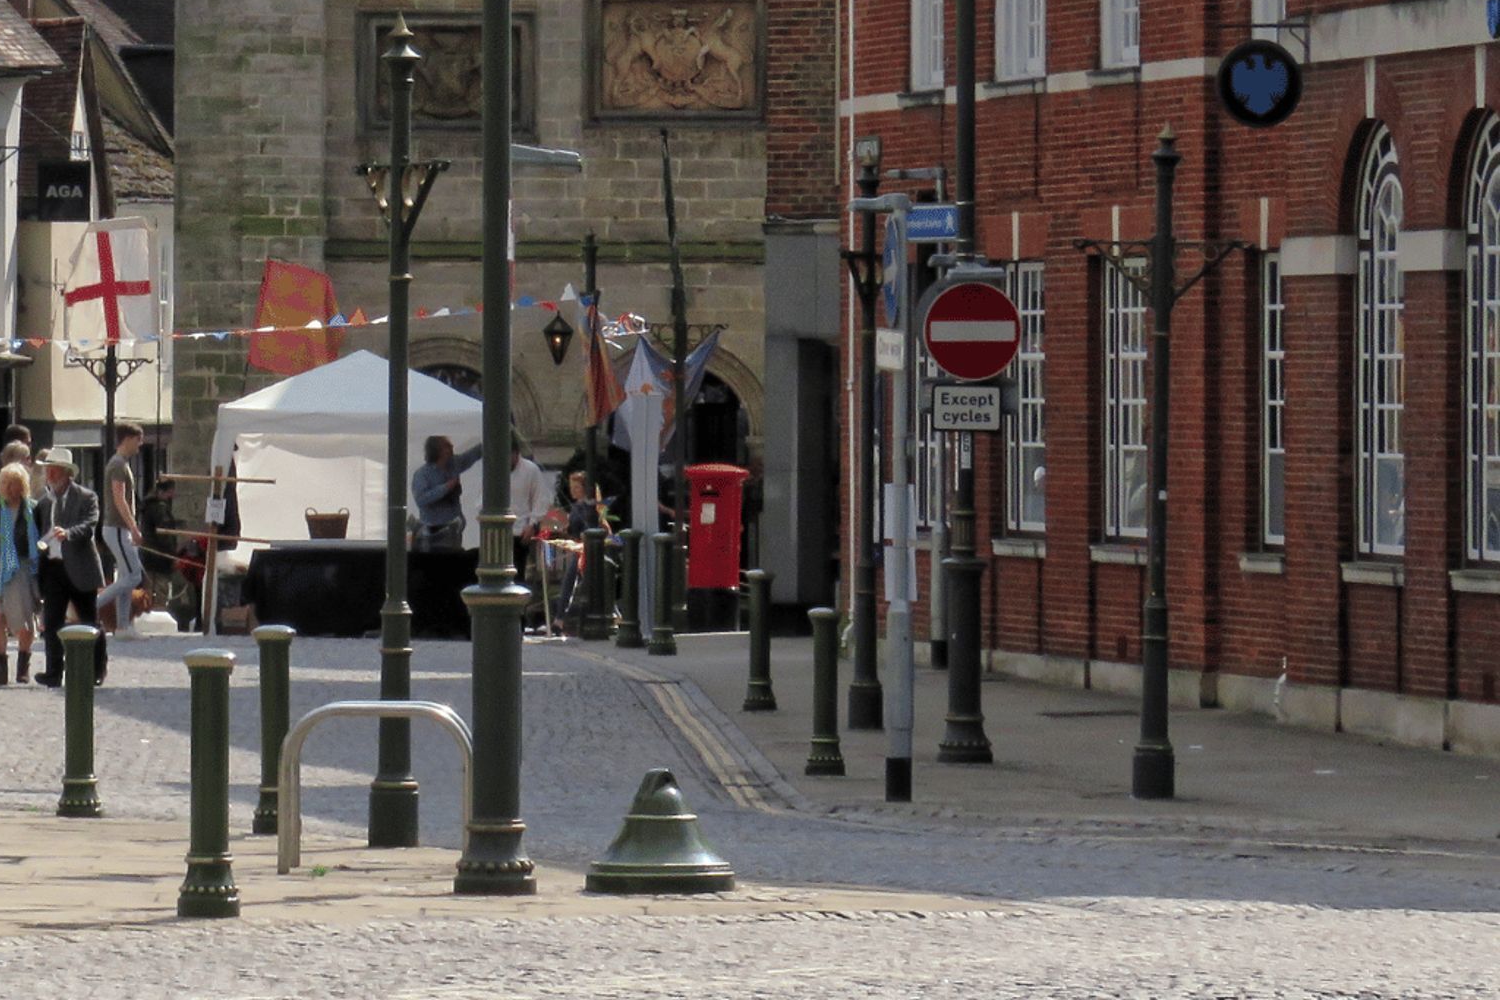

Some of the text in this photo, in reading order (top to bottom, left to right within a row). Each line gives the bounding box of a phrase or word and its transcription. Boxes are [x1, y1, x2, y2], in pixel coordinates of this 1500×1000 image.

[46, 184, 84, 198] AGA
[941, 393, 994, 407] Except
[943, 411, 991, 424] cycles
